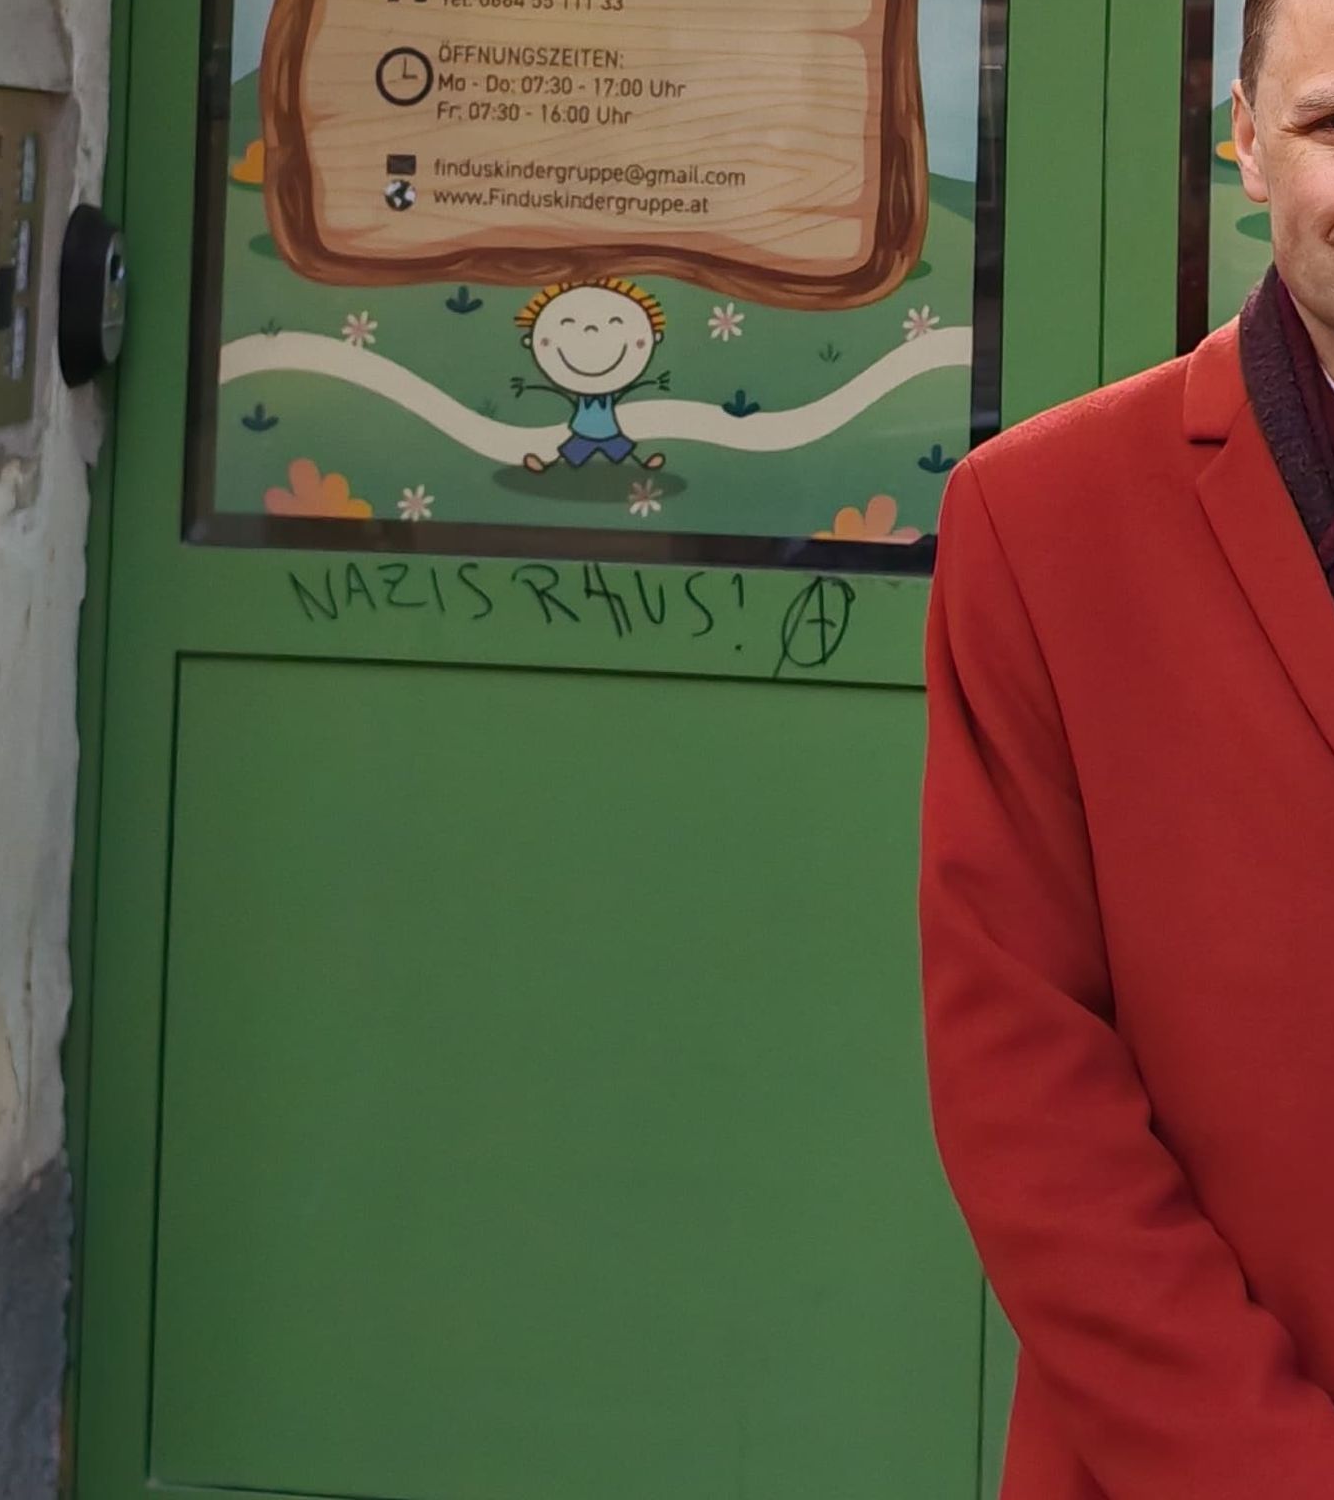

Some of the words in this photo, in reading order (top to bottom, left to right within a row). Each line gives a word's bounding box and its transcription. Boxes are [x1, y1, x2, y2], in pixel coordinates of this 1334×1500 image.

[438, 41, 624, 69] ÖFFNUNGSZEITEN:
[438, 73, 466, 92] Mo
[486, 75, 516, 94] Do:
[521, 76, 573, 95] 07:30
[594, 78, 643, 97] 17:00
[649, 80, 686, 98] Uhr
[468, 103, 520, 122] 07:30
[541, 105, 590, 124] 16:00
[597, 107, 632, 125] Uhr
[434, 158, 746, 187] finduskindergruppe@gmail.com
[433, 188, 709, 217] www.Finduskindergruppe.at
[290, 562, 493, 621] NAZIS
